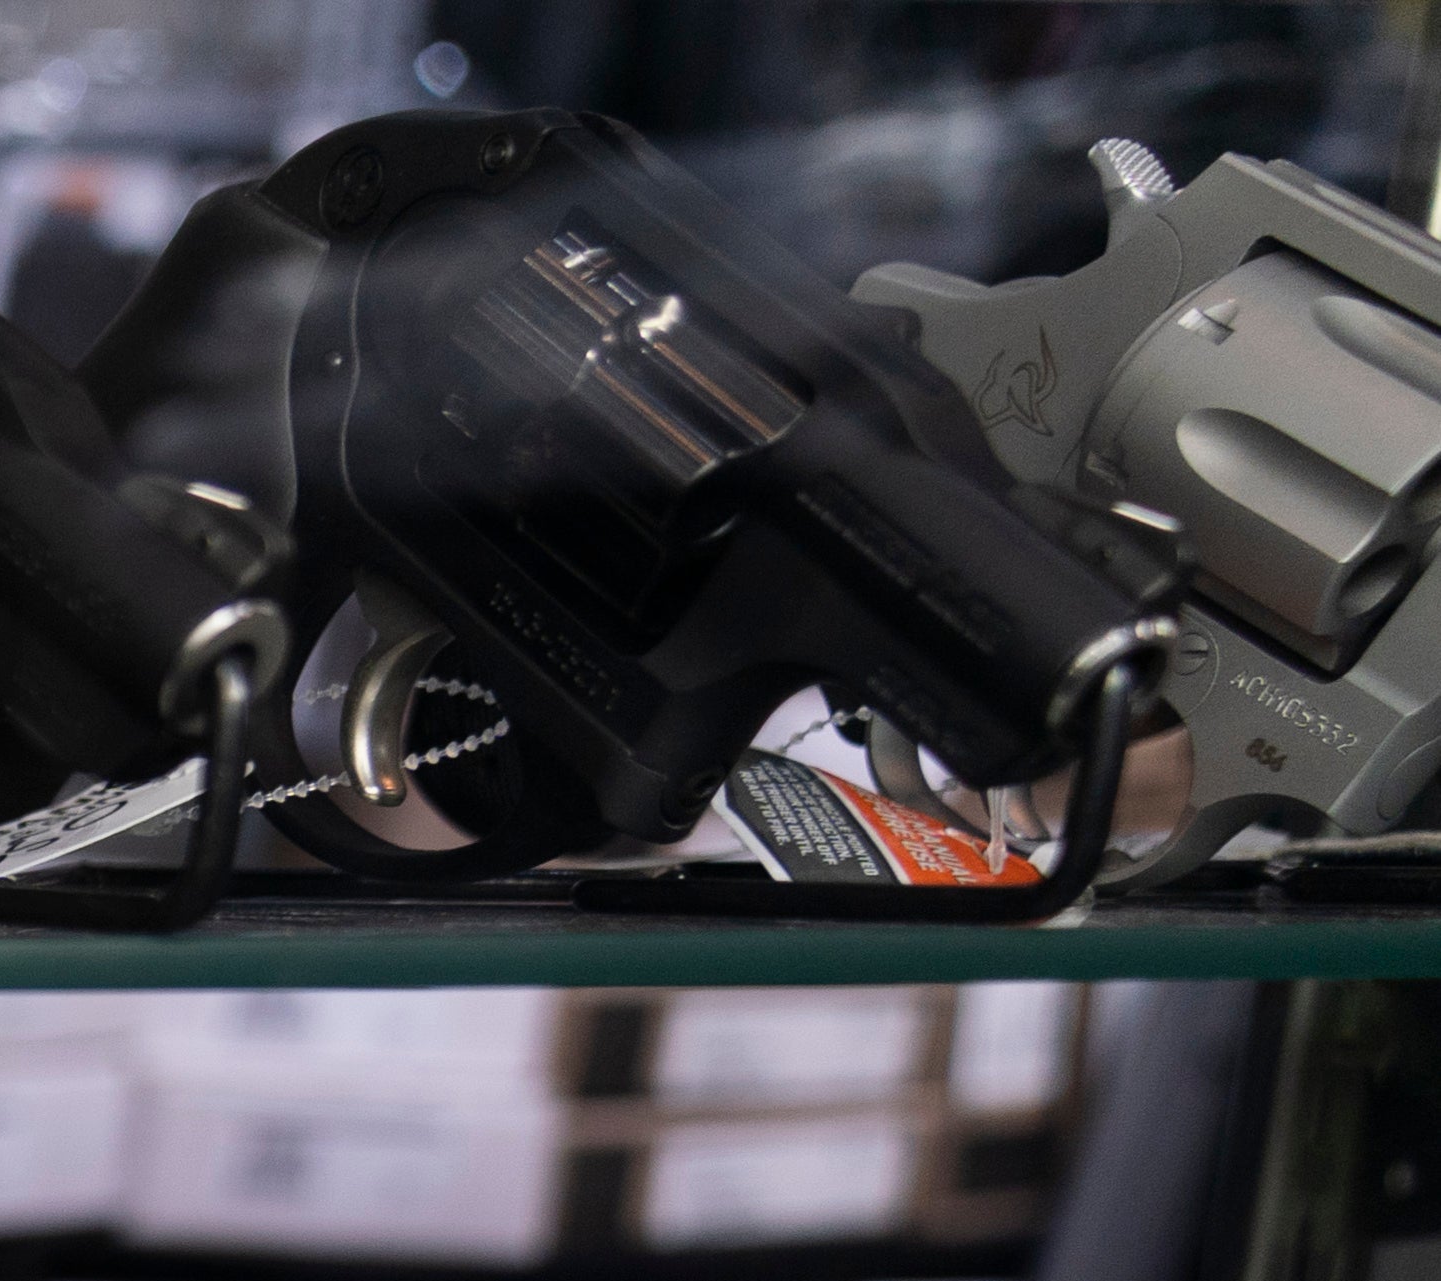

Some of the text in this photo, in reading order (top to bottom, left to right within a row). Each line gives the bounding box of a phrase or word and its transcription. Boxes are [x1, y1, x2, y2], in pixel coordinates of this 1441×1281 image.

[738, 768, 767, 804] READY
[765, 817, 789, 846] FIRE.
[762, 782, 797, 824] TRIGGER
[788, 823, 813, 856] UNTIL
[793, 806, 826, 843] FINGER
[816, 843, 838, 863] OFF
[843, 826, 879, 876] POINTED
[900, 837, 943, 872] USE
